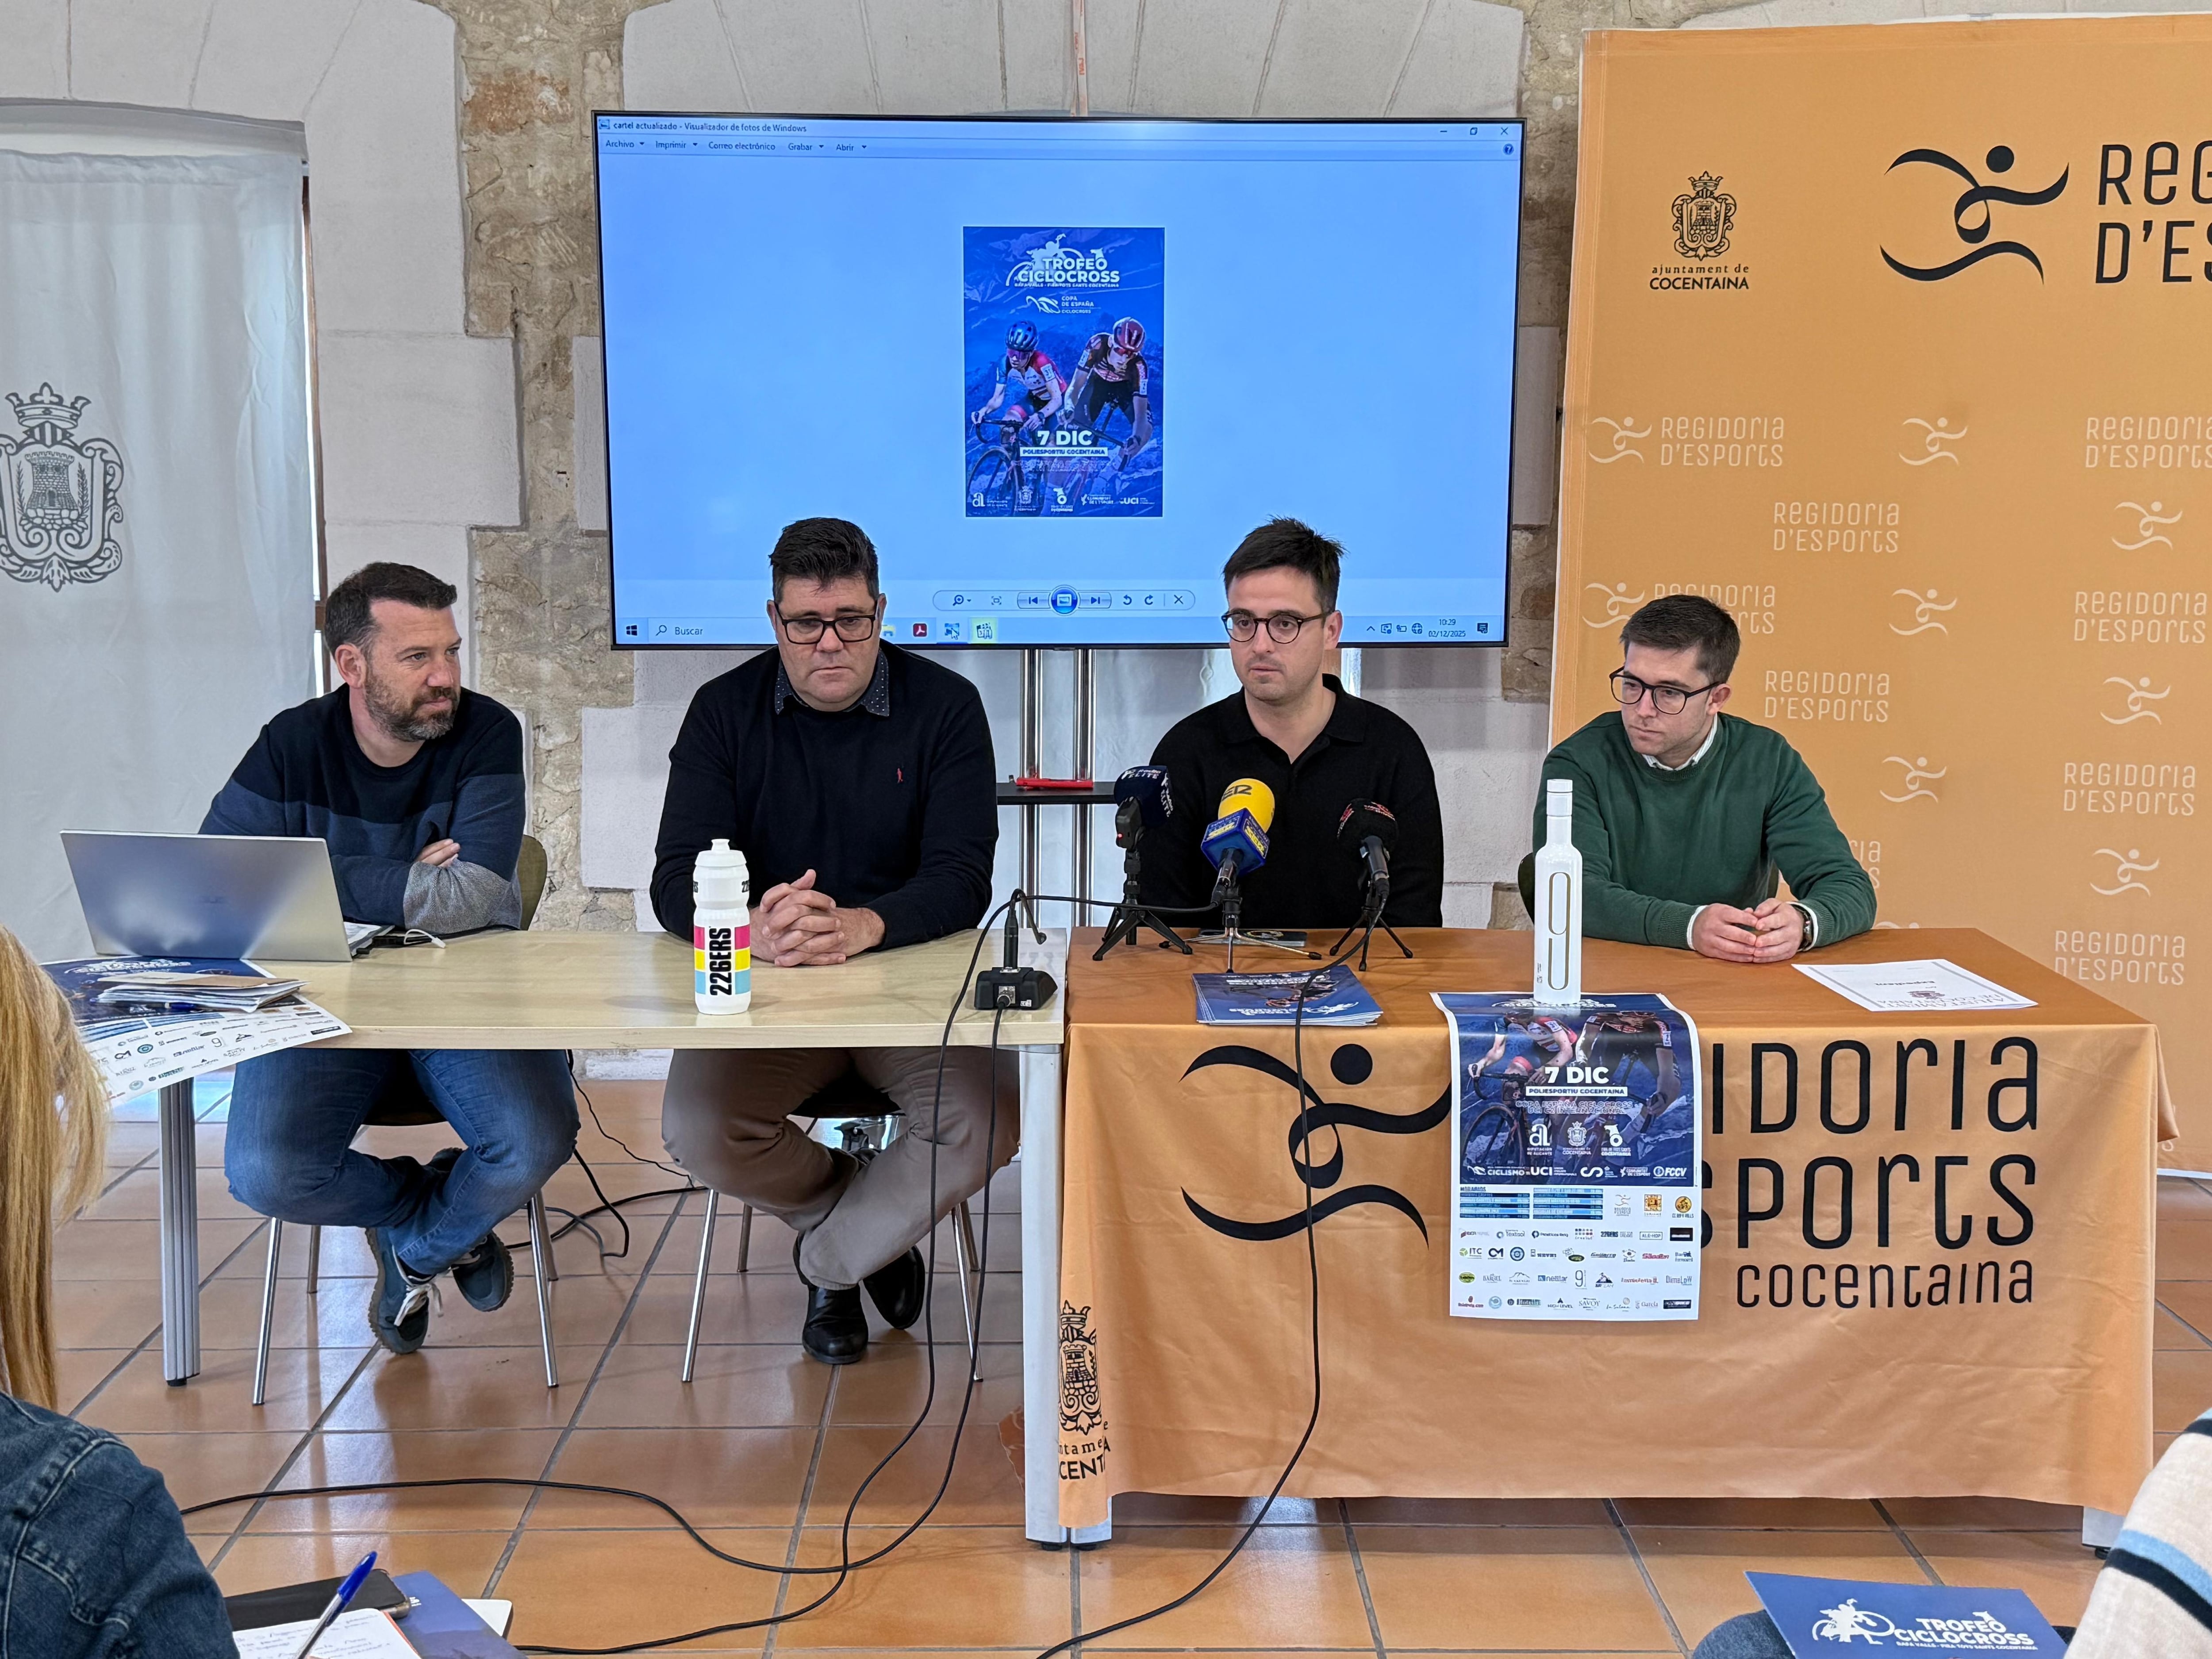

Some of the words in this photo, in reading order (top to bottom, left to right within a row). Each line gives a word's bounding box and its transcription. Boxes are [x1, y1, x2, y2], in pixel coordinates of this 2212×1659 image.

[684, 123, 729, 131] Visualizador
[656, 141, 687, 150] Imprimir
[735, 142, 776, 150] electrónico
[788, 143, 813, 151] Grabar
[1042, 257, 1108, 270] TROFEO
[1652, 264, 1728, 276] ajuntament
[1734, 264, 1749, 273] de
[1018, 270, 1120, 283] CICLOCROSS
[1650, 277, 1749, 290] COCENTAINA
[1037, 430, 1050, 445] 7
[1056, 430, 1093, 445] DIC
[675, 626, 703, 636] Buscar
[709, 927, 732, 996] 226ERS
[1545, 1067, 1559, 1083] 7
[1567, 1067, 1609, 1083] DIC
[1531, 1167, 1552, 1175] UCI
[1664, 1167, 1687, 1177] FCCV
[1916, 1618, 2007, 1633] TROFEO
[1894, 1628, 2035, 1645] CICLOCROSS
